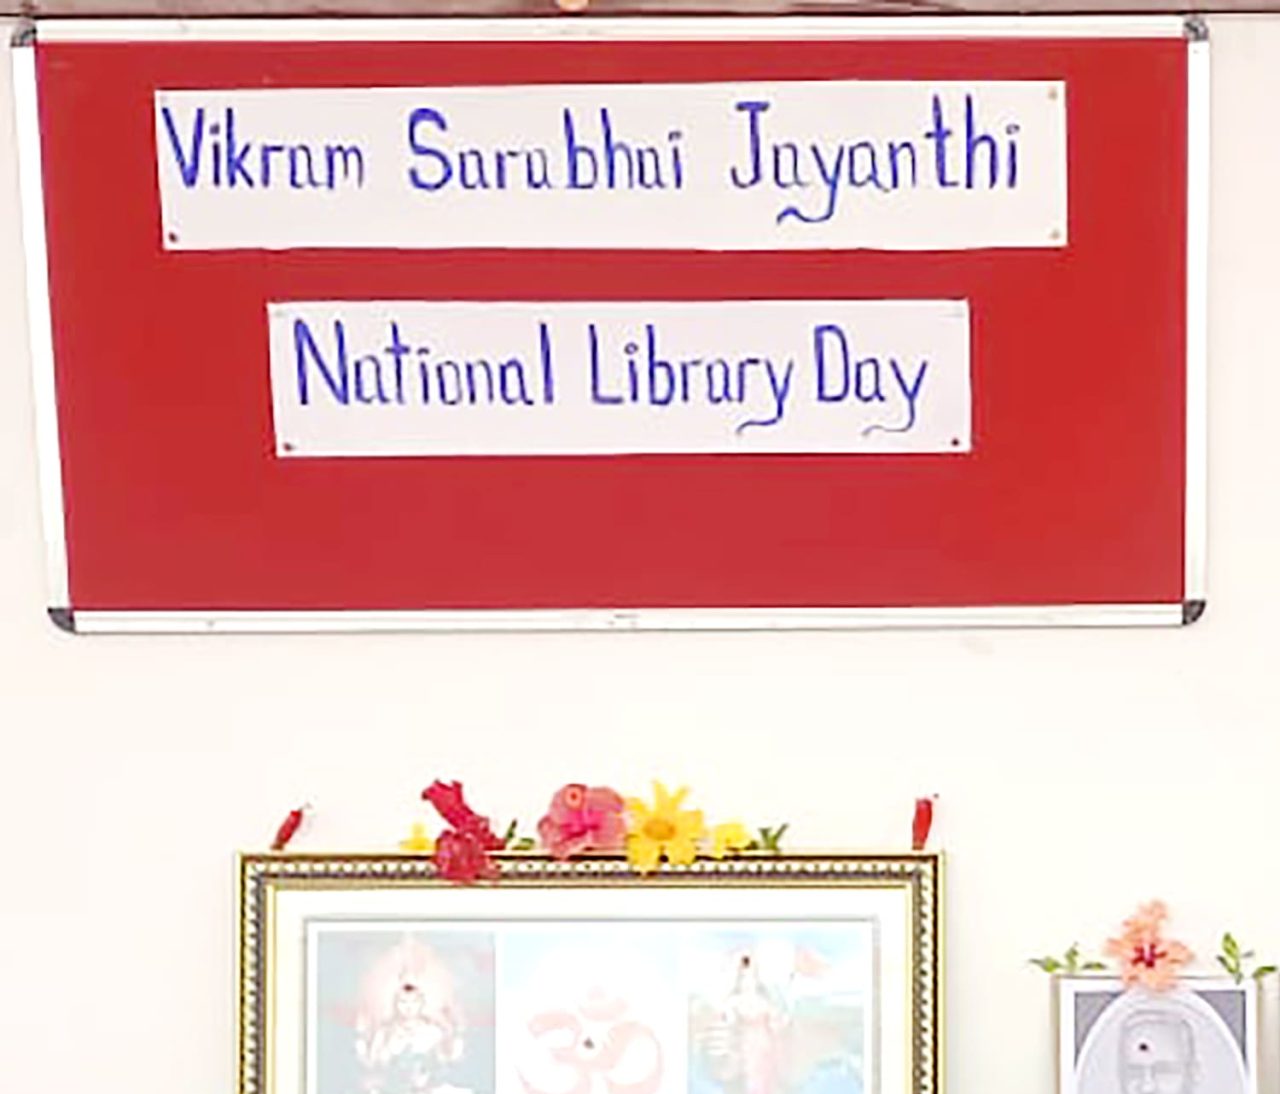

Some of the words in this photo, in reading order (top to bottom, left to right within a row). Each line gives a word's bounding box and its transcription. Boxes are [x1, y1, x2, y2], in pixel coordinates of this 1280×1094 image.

[161, 106, 364, 190] Vikram
[407, 108, 683, 192] Sarabhai
[730, 93, 1021, 224] Jayanthi
[293, 319, 554, 406] National
[588, 323, 795, 434] Library
[814, 324, 929, 435] Day
